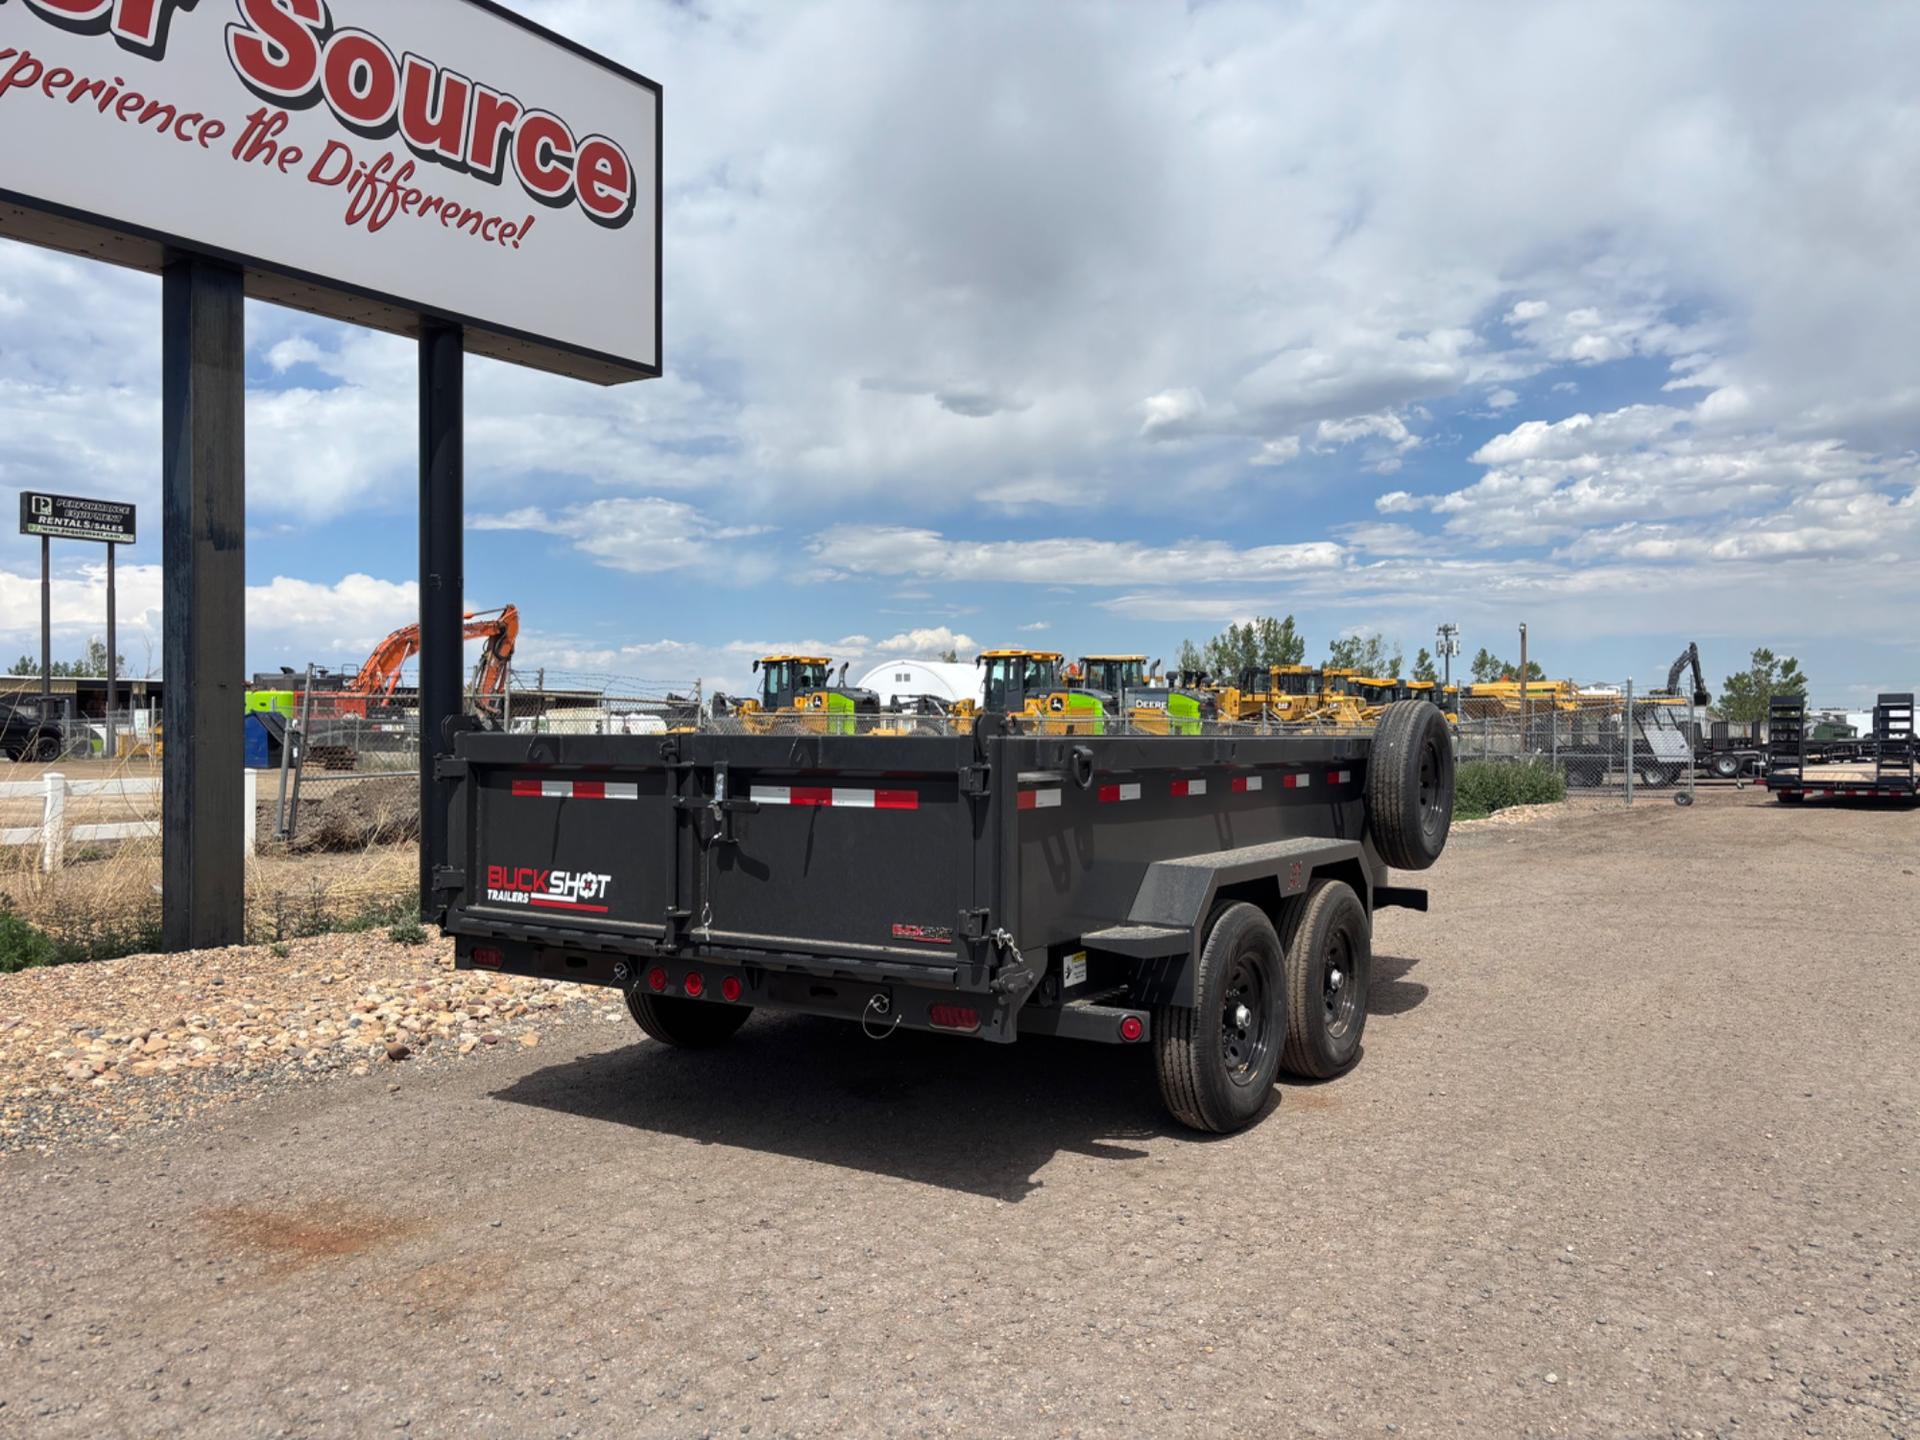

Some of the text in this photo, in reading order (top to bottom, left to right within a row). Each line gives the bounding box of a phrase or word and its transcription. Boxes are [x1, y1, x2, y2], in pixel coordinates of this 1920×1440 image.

[226, 0, 638, 228] Source
[231, 107, 303, 173] the
[307, 139, 535, 249] Difference!
[1135, 699, 1167, 709] DEERE
[487, 865, 612, 900] BUCKSHOT
[487, 889, 529, 904] TRAILERS
